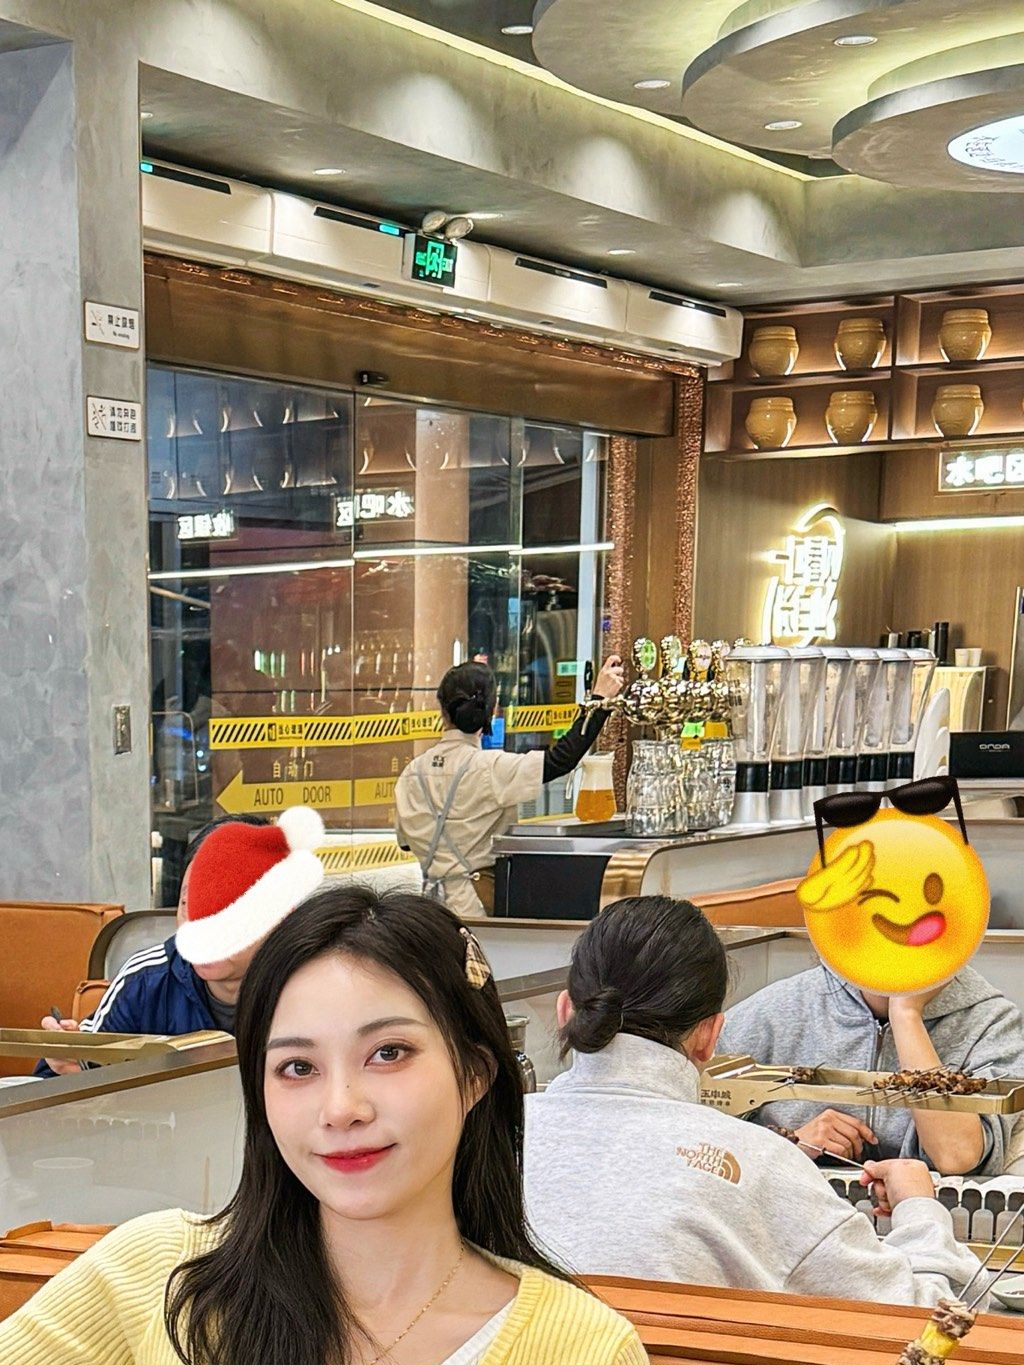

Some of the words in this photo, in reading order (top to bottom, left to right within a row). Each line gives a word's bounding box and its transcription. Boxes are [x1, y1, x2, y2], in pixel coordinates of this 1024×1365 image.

[273, 760, 314, 778] 自动门
[254, 788, 284, 806] AUTO
[303, 786, 332, 803] DOOR
[375, 782, 396, 799] AUT
